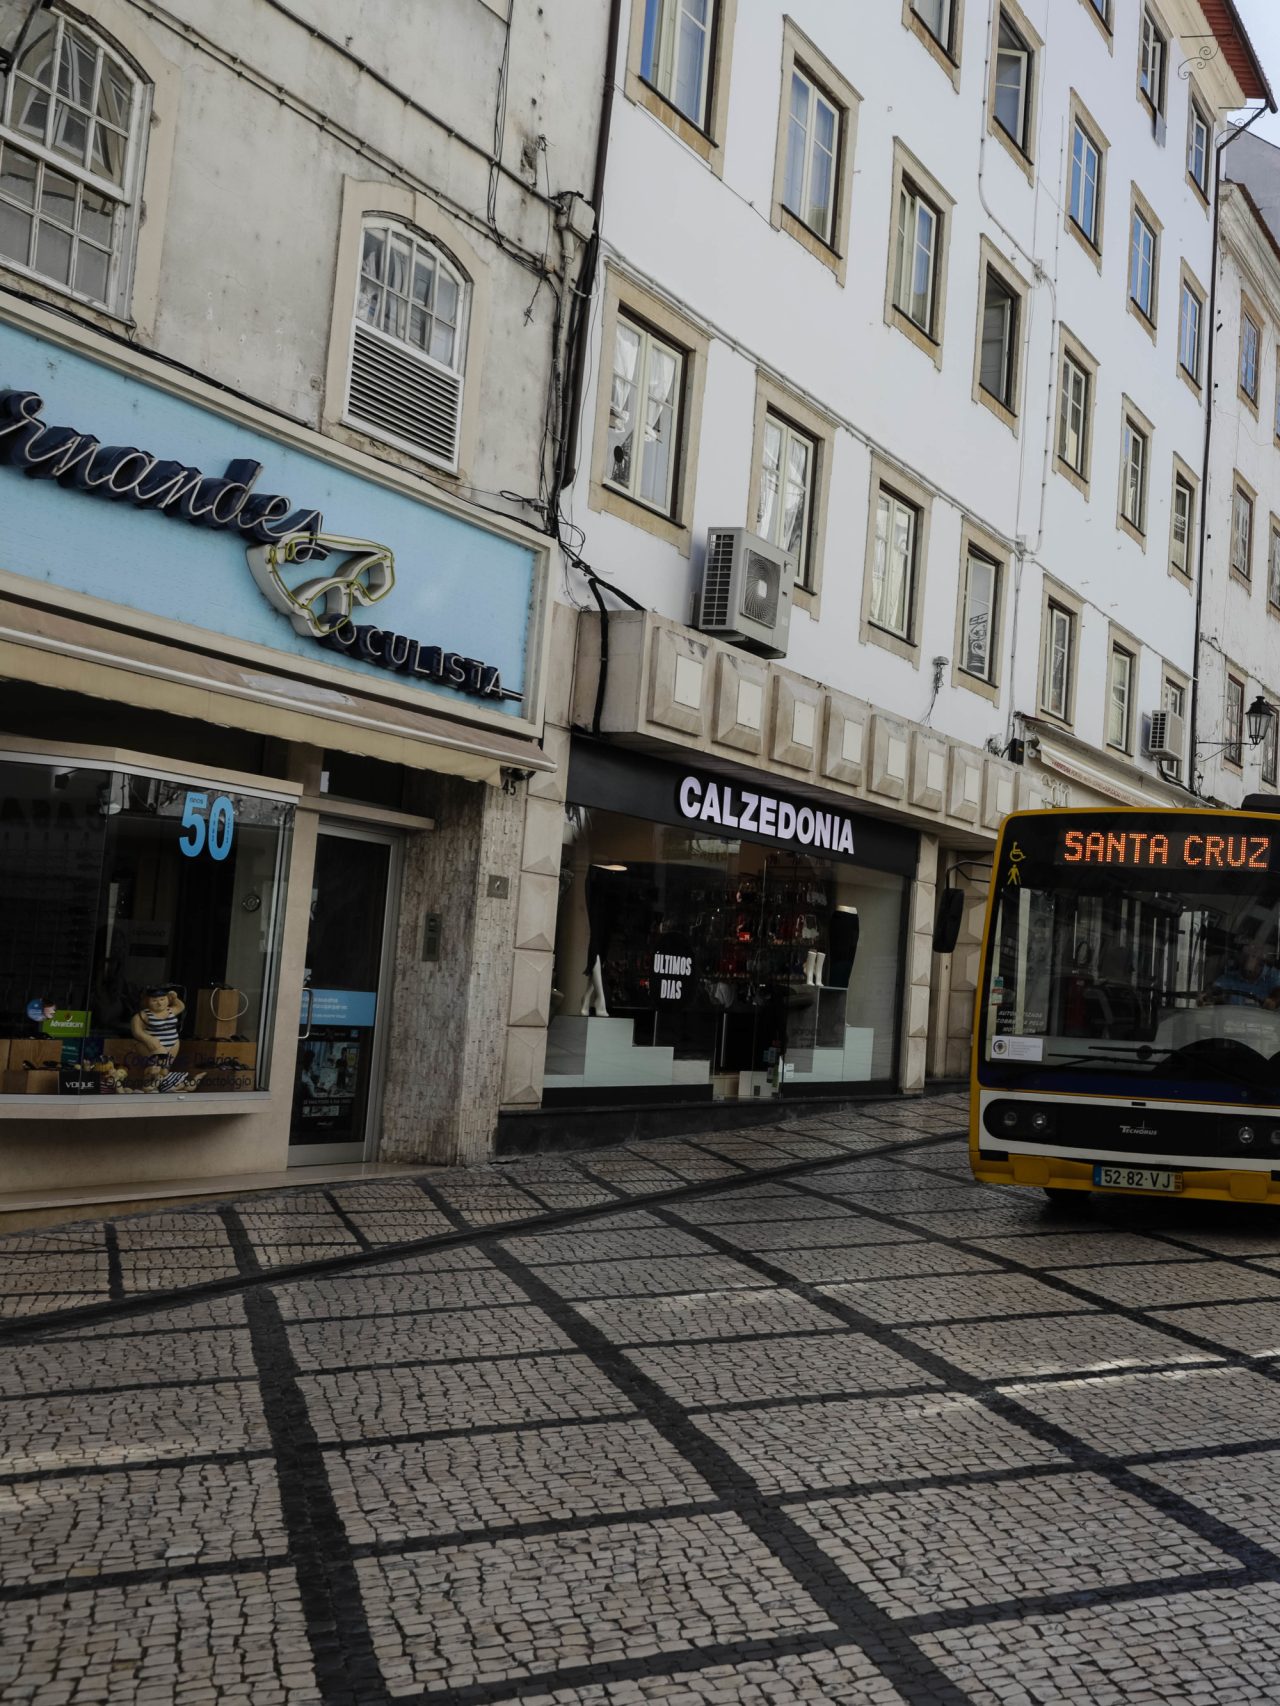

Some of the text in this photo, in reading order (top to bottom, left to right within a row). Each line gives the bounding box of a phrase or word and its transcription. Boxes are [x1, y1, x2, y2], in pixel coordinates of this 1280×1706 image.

[0, 388, 330, 564] rnandes
[328, 614, 526, 702] OCULISTA
[502, 778, 517, 796] 45
[178, 791, 235, 861] 50
[680, 776, 854, 854] CALZEDONIA
[1064, 831, 1270, 868] SANTA CRUZ
[653, 950, 692, 976] ÚLTIMOS
[660, 979, 682, 999] DIAS
